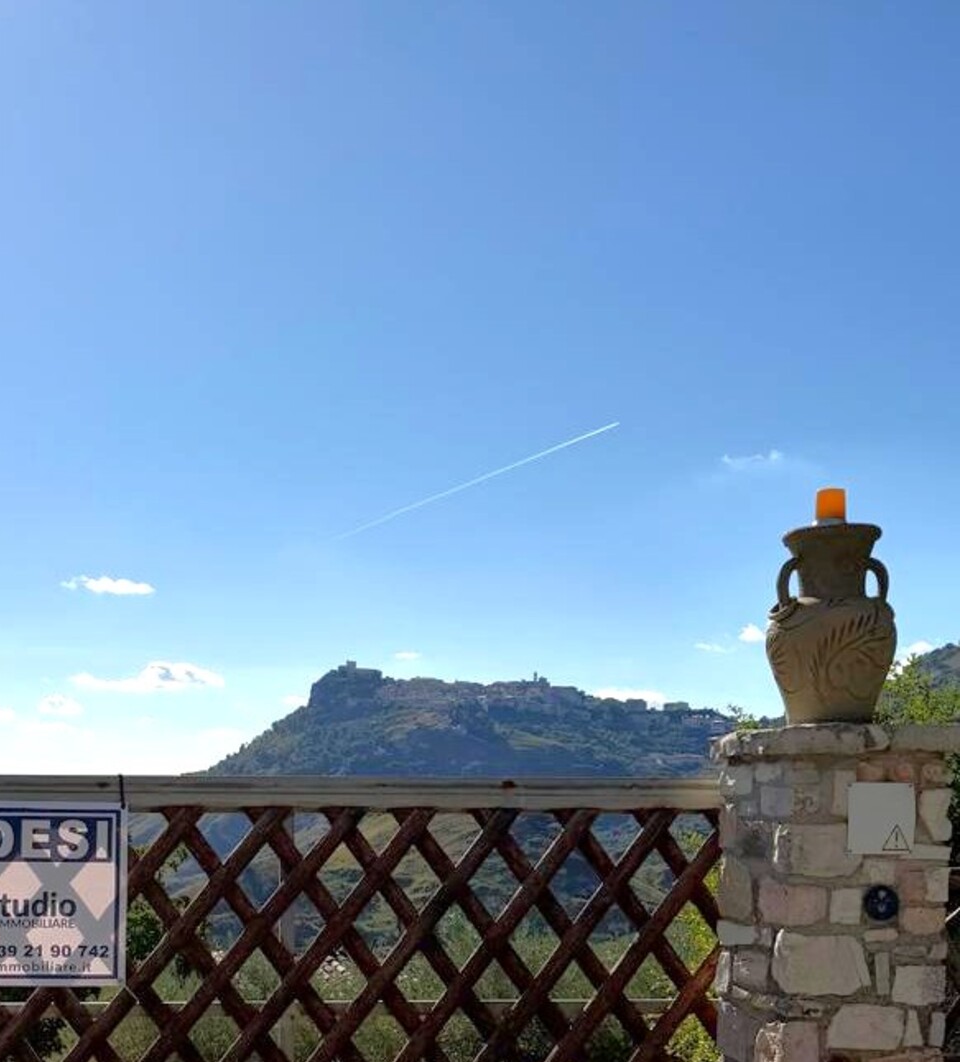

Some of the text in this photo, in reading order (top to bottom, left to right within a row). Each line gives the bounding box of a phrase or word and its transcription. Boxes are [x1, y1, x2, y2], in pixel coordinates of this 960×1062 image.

[23, 944, 43, 959] 21
[49, 944, 72, 959] 90
[77, 944, 110, 959] 742
